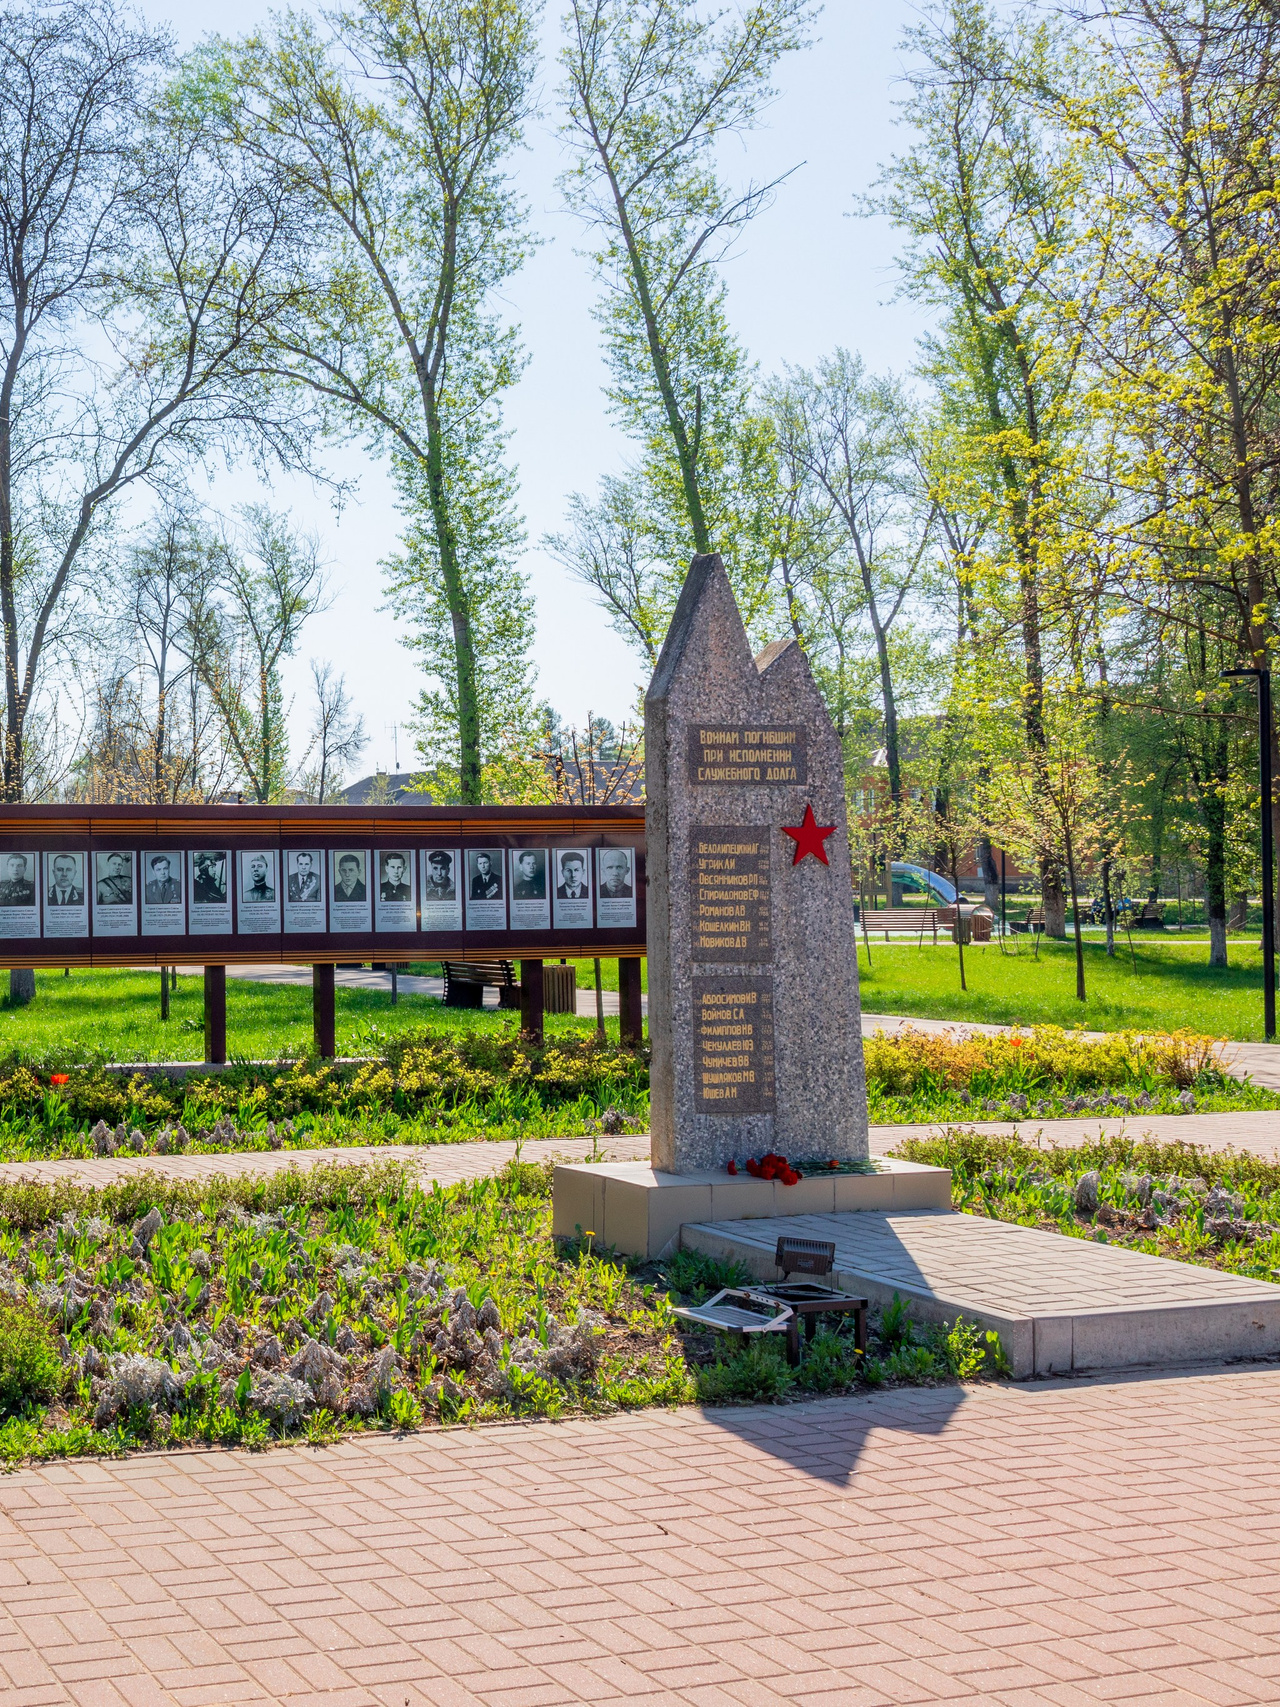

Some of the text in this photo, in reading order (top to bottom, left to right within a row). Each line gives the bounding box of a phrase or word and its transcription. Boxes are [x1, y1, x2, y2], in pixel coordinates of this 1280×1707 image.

[700, 730, 796, 744] ВОИНАМ ПОГИБШИМ
[703, 749, 792, 762] ПРИ ИСПОЛНЕНИИ
[698, 767, 797, 780] СЛУЖЕБНОГО ДОЛГА
